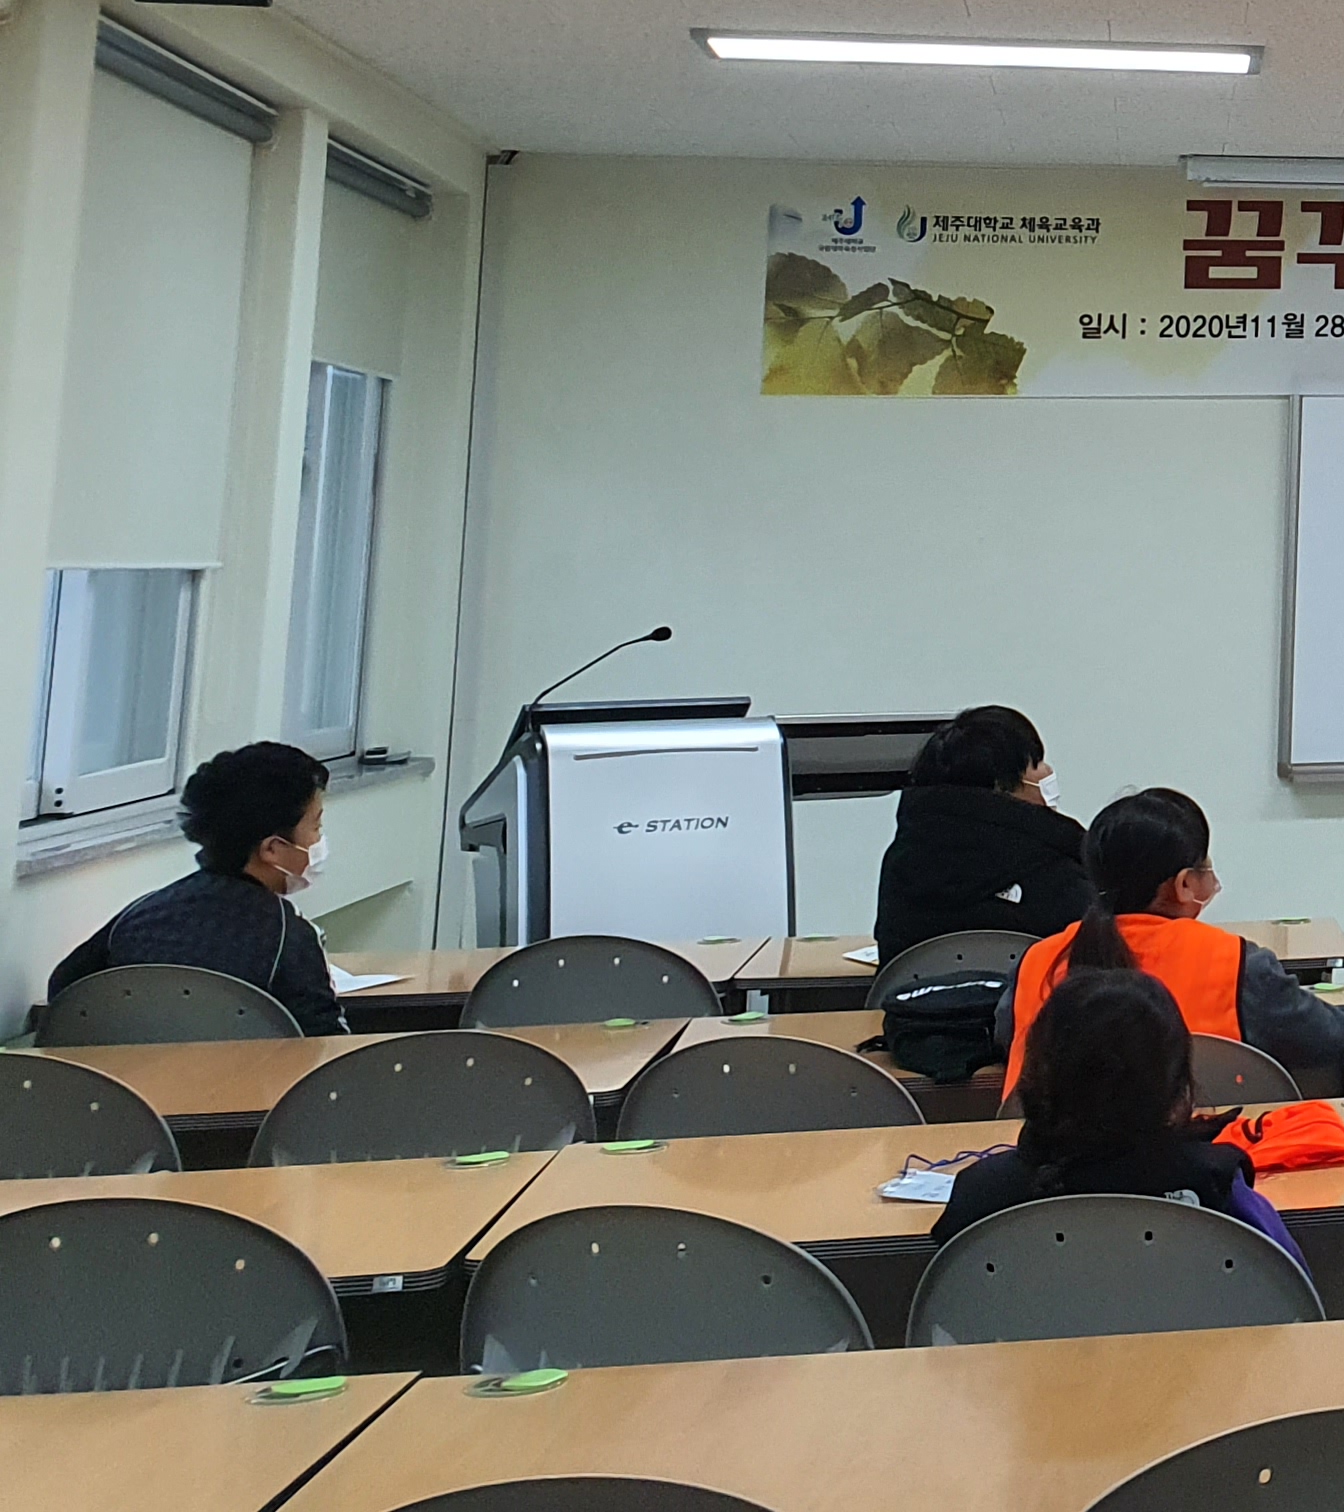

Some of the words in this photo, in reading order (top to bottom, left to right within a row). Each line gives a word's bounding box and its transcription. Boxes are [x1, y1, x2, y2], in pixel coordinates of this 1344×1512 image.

[932, 215, 1015, 232] 제주대학교
[1019, 216, 1101, 234] 체육교육과
[932, 234, 958, 244] JEJU
[963, 233, 1023, 244] NATIONAL
[1029, 234, 1097, 244] UNIVERSITY
[1079, 313, 1127, 339] 일시
[1159, 313, 1304, 339] 2020년11월
[645, 816, 729, 832] STATION
